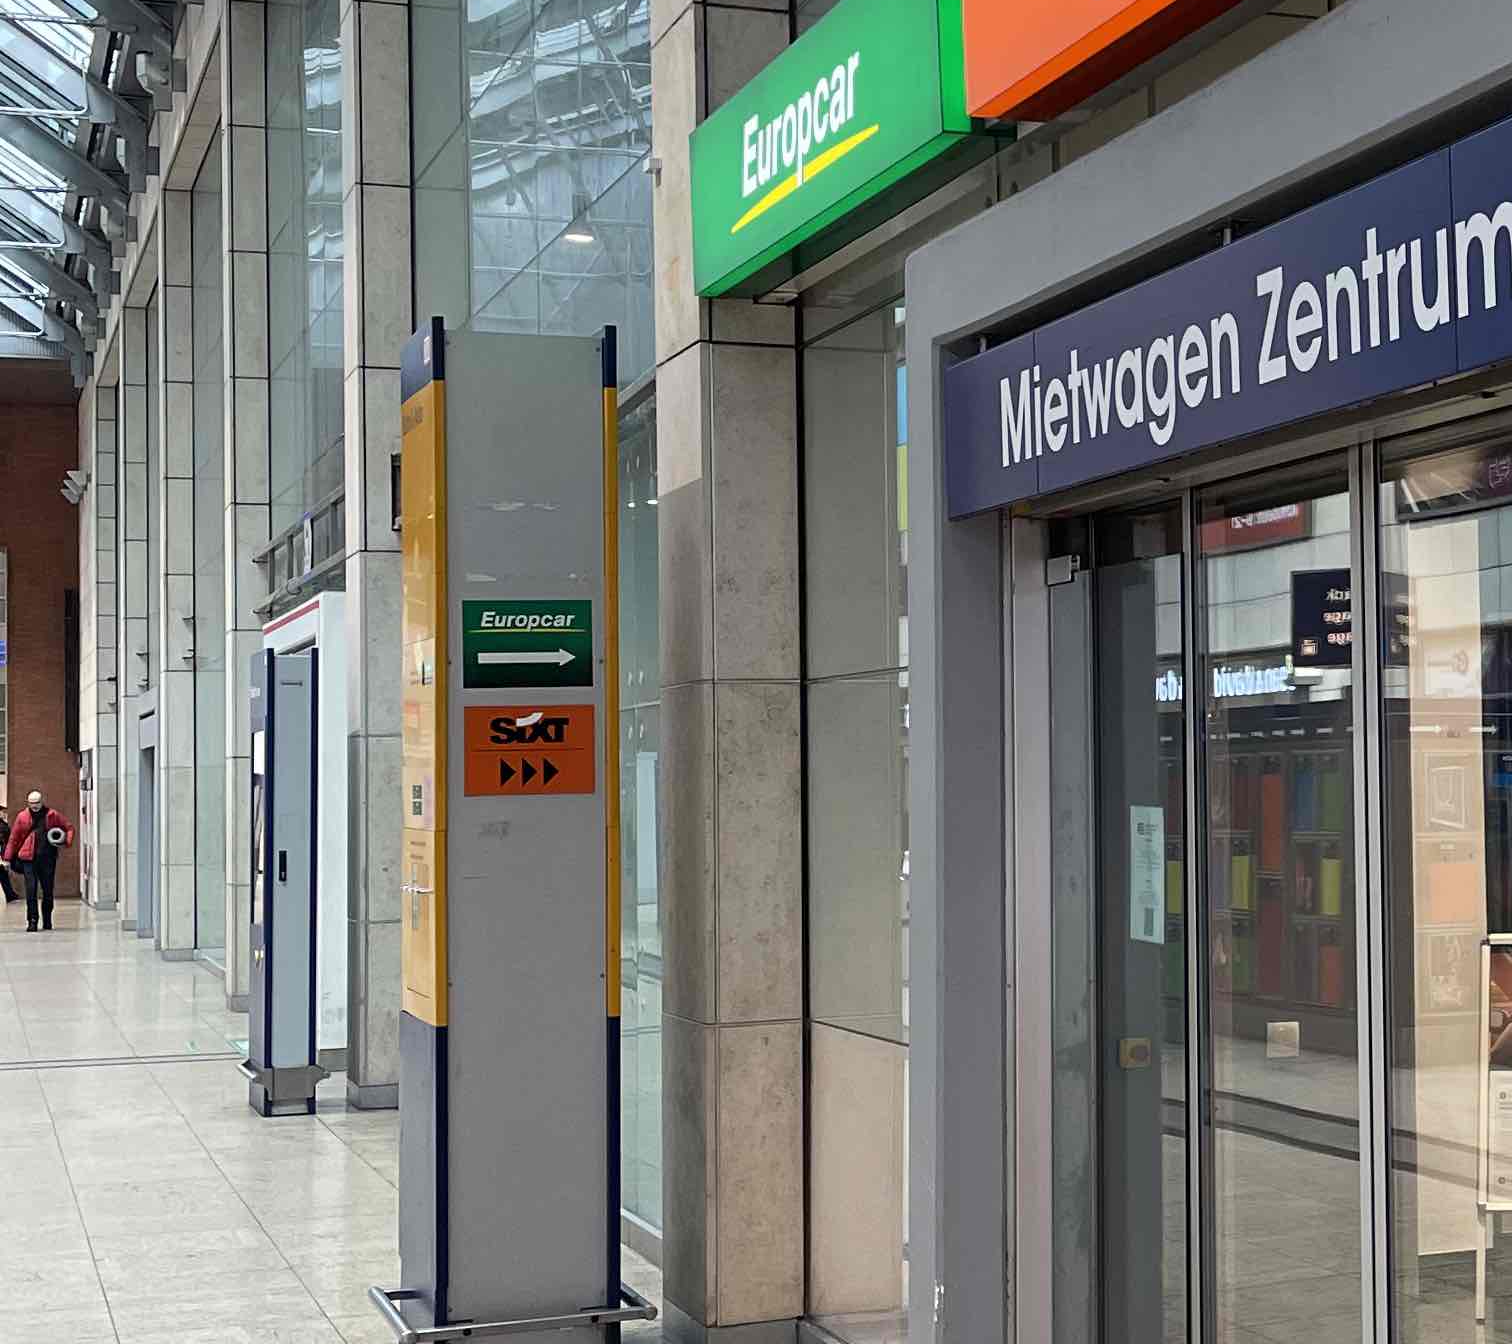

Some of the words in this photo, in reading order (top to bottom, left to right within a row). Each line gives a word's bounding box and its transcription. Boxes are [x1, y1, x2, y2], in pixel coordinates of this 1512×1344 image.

[741, 50, 860, 198] Europcar
[1000, 310, 1241, 468] Mietwagen
[480, 611, 575, 632] Europcar
